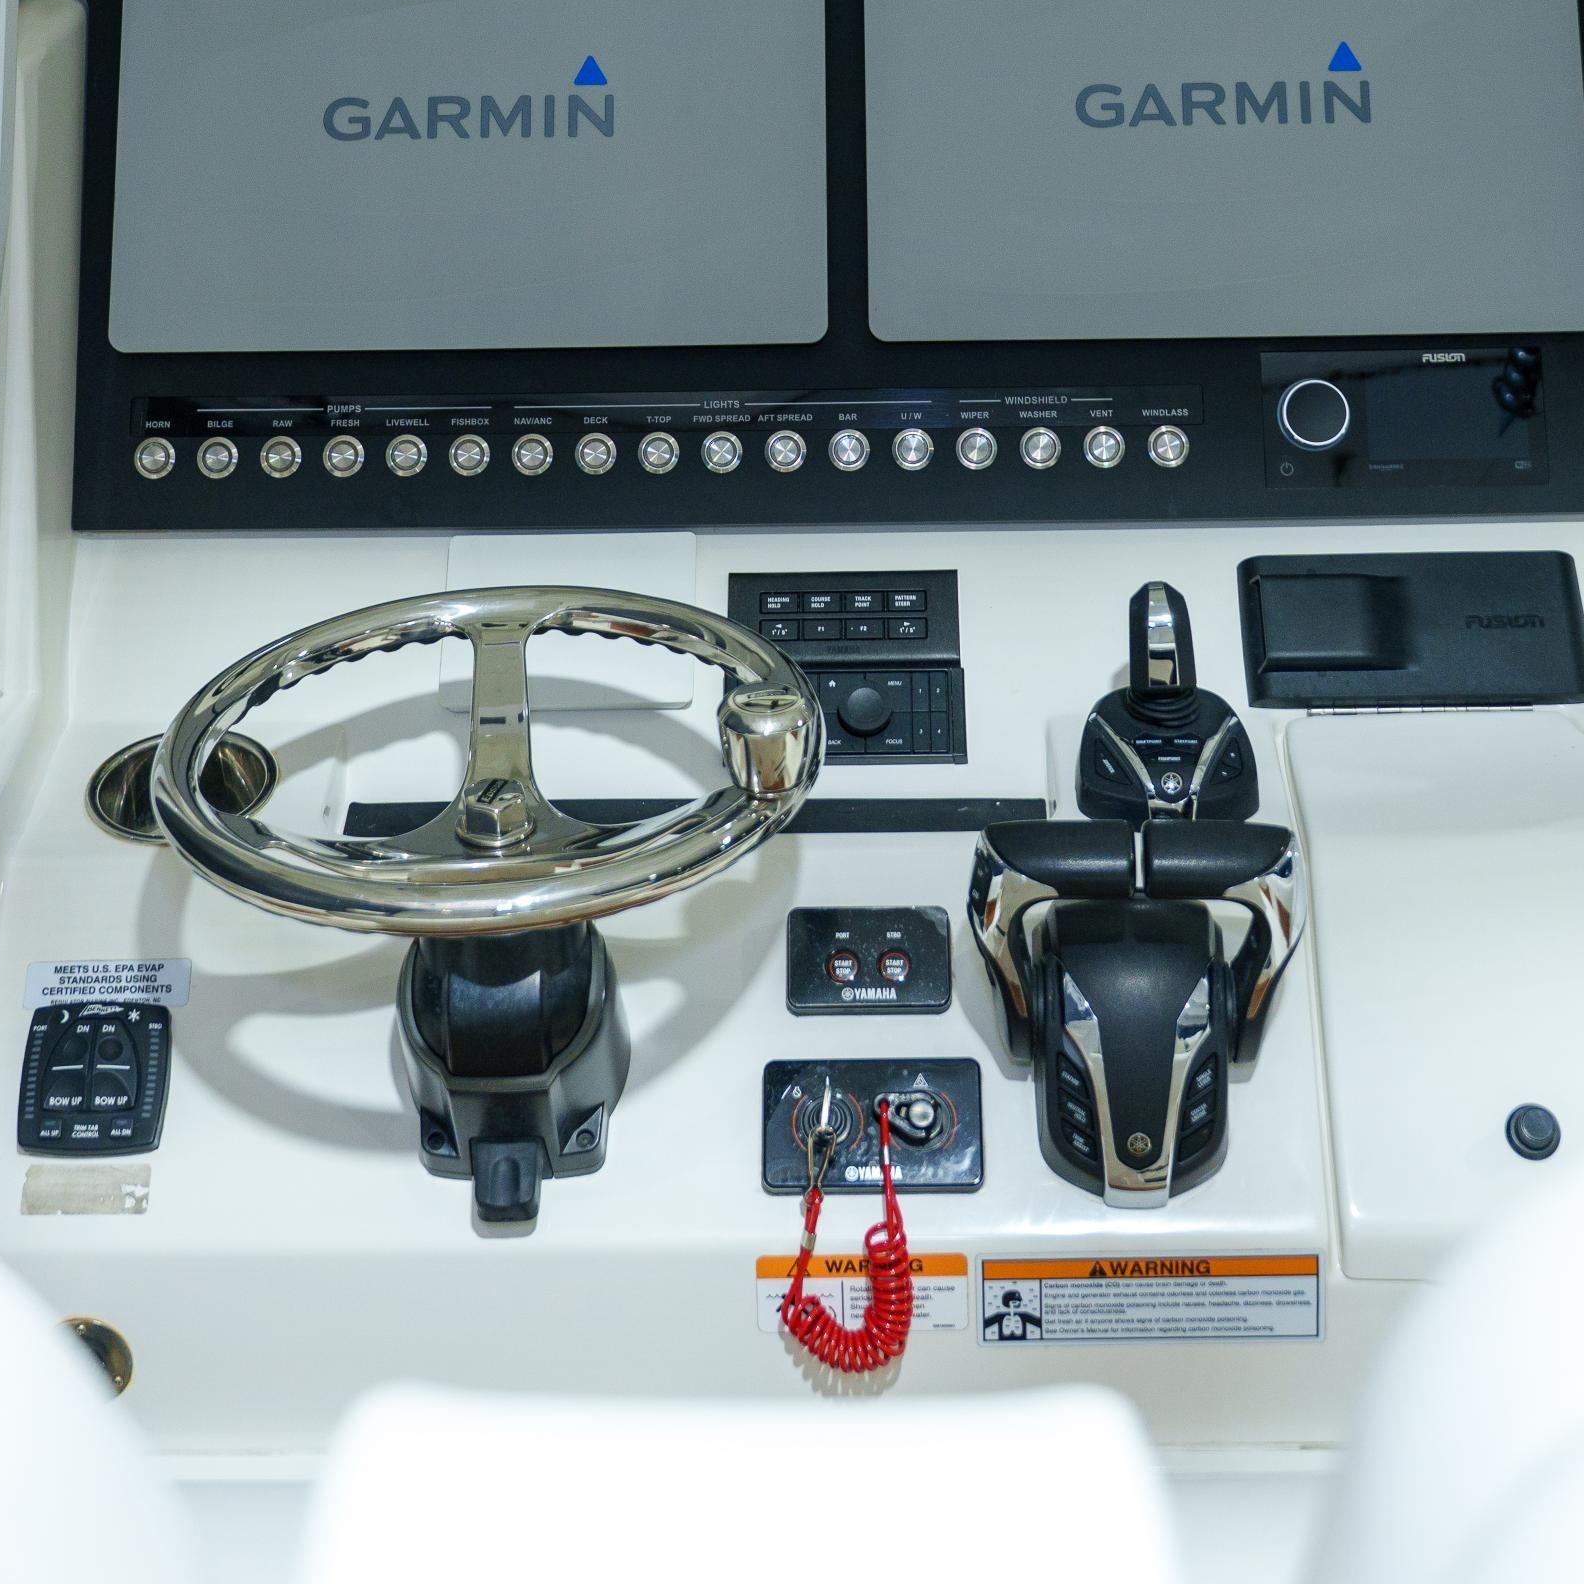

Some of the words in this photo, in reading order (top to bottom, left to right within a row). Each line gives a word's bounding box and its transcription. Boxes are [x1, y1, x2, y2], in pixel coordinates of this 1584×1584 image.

[1075, 80, 1372, 128] GARMIN
[323, 94, 615, 141] GARMIN
[1422, 353, 1466, 363] FUSION
[1005, 395, 1068, 405] WINDSHIELD
[703, 400, 740, 409] LIGHTS
[327, 405, 361, 413] PUMPS
[1090, 409, 1113, 417] VENT
[1142, 408, 1189, 416] WINDLASS
[693, 414, 713, 422] FWD
[714, 414, 751, 422] SPREAD
[776, 413, 813, 421] SPREAD
[838, 412, 857, 420] BAR
[960, 410, 989, 419] WIPER
[1019, 410, 1058, 418] WASHER
[273, 419, 293, 427] RAW
[386, 418, 430, 426] LIVEWELL
[514, 417, 553, 425] NAV/ANC
[583, 416, 608, 424] DECK
[646, 415, 672, 423] T-TOP
[145, 420, 171, 428] HORN
[207, 420, 234, 428] BILGE
[1465, 614, 1545, 629] FUSION
[54, 965, 89, 974] MEETS
[92, 965, 112, 973] U.S.
[114, 964, 135, 973] EPA
[137, 963, 165, 972] EVAP
[59, 975, 122, 984] STANDARDS
[125, 974, 158, 983] USING
[42, 986, 96, 995] CERTIFIED
[98, 984, 173, 994] COMPONENTS
[854, 987, 897, 999] YAMAHA
[76, 1024, 90, 1032] DN
[102, 1024, 115, 1032] DN
[49, 1096, 70, 1105] BOW
[71, 1096, 83, 1105] UP
[95, 1096, 116, 1105] BOW
[116, 1096, 128, 1105] UP
[858, 1166, 903, 1180] YAMA
[825, 1260, 923, 1273] WARG
[1109, 1260, 1211, 1276] WARNING
[1156, 1325, 1187, 1333] regarding
